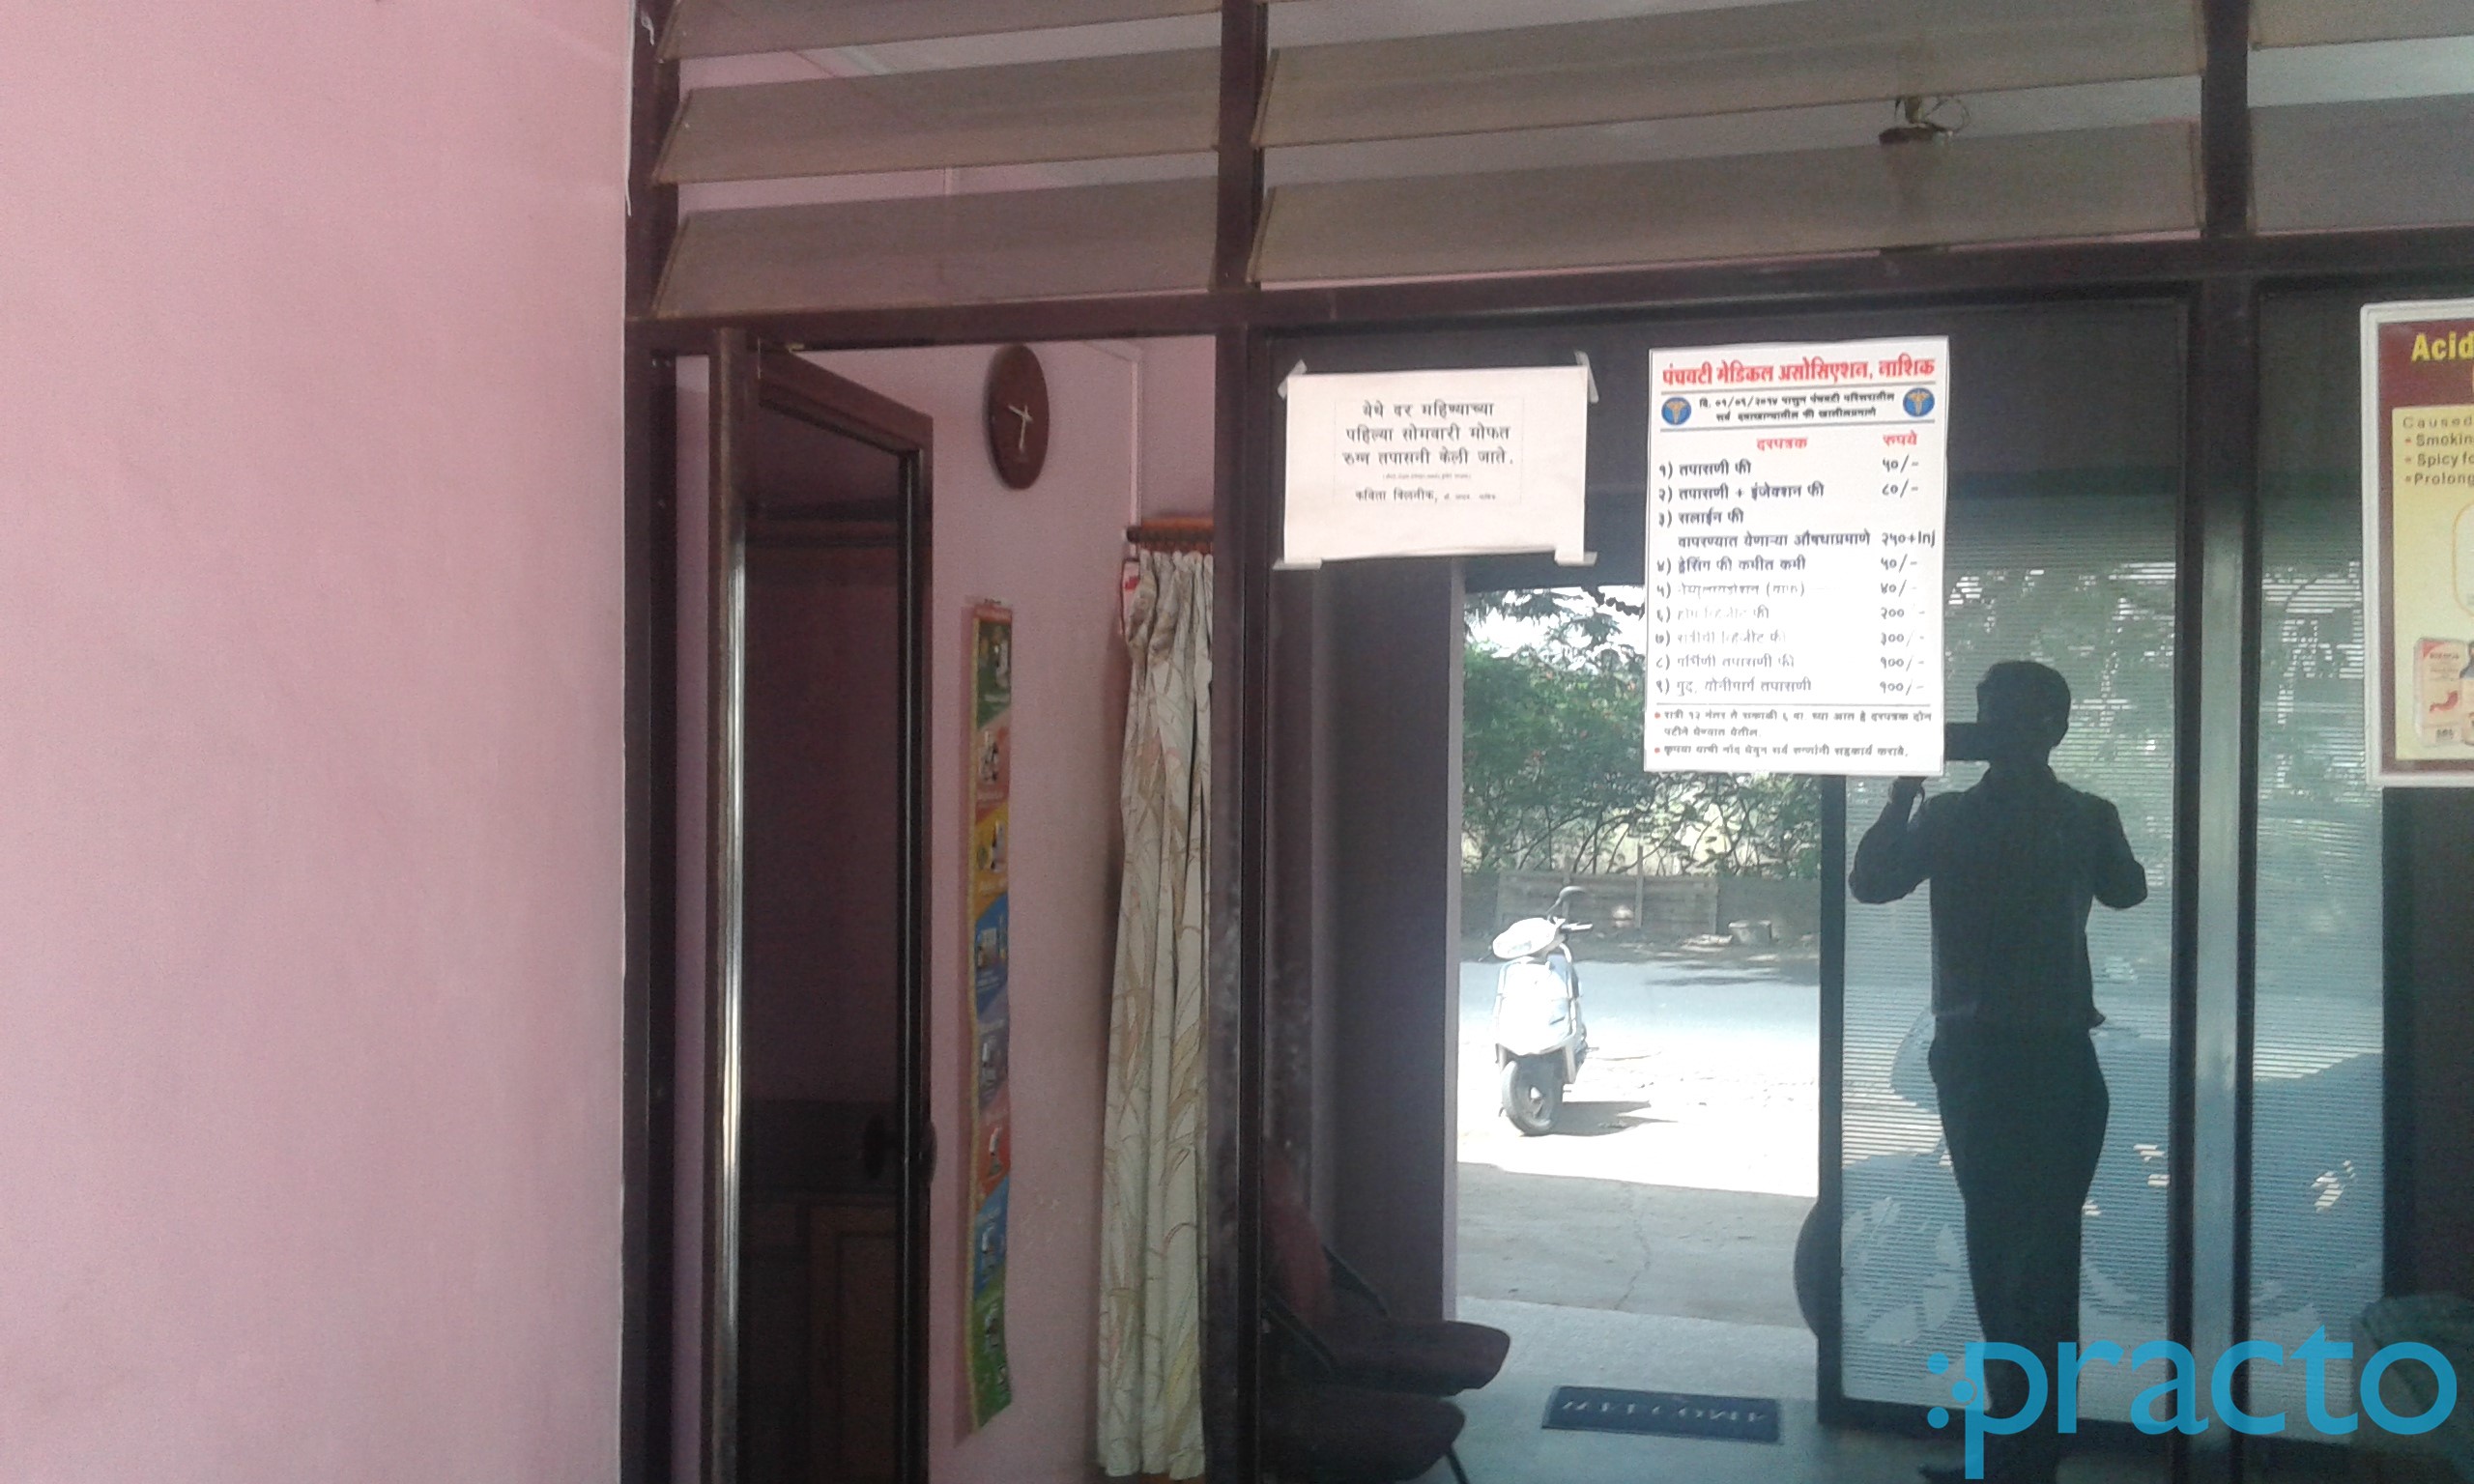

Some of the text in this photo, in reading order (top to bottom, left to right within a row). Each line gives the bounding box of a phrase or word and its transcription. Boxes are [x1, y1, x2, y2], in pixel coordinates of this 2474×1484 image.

[1663, 353, 1934, 386] पंचवटी मेडिकल असोसिएशन, नाशिक
[1346, 422, 1510, 444] पहिल्या सोमवारी मोफत
[2416, 433, 2474, 448] Smokin
[1756, 437, 1808, 451] दरपत्रक
[1439, 446, 1469, 465] केली
[2417, 452, 2459, 470] Spicy
[1680, 458, 1729, 477] तपासणी
[1735, 458, 1751, 475] फी
[1680, 483, 1729, 501] तपासणी
[1751, 481, 1801, 501] इंजेक्शन
[1807, 480, 1825, 497] फी
[1679, 508, 1722, 527] सलाईन
[1727, 507, 1743, 524] फी
[1716, 556, 1733, 572] फी
[1739, 554, 1773, 572] कमीत
[1780, 554, 1805, 571] कमी
[1761, 677, 1812, 693] तपासणी
